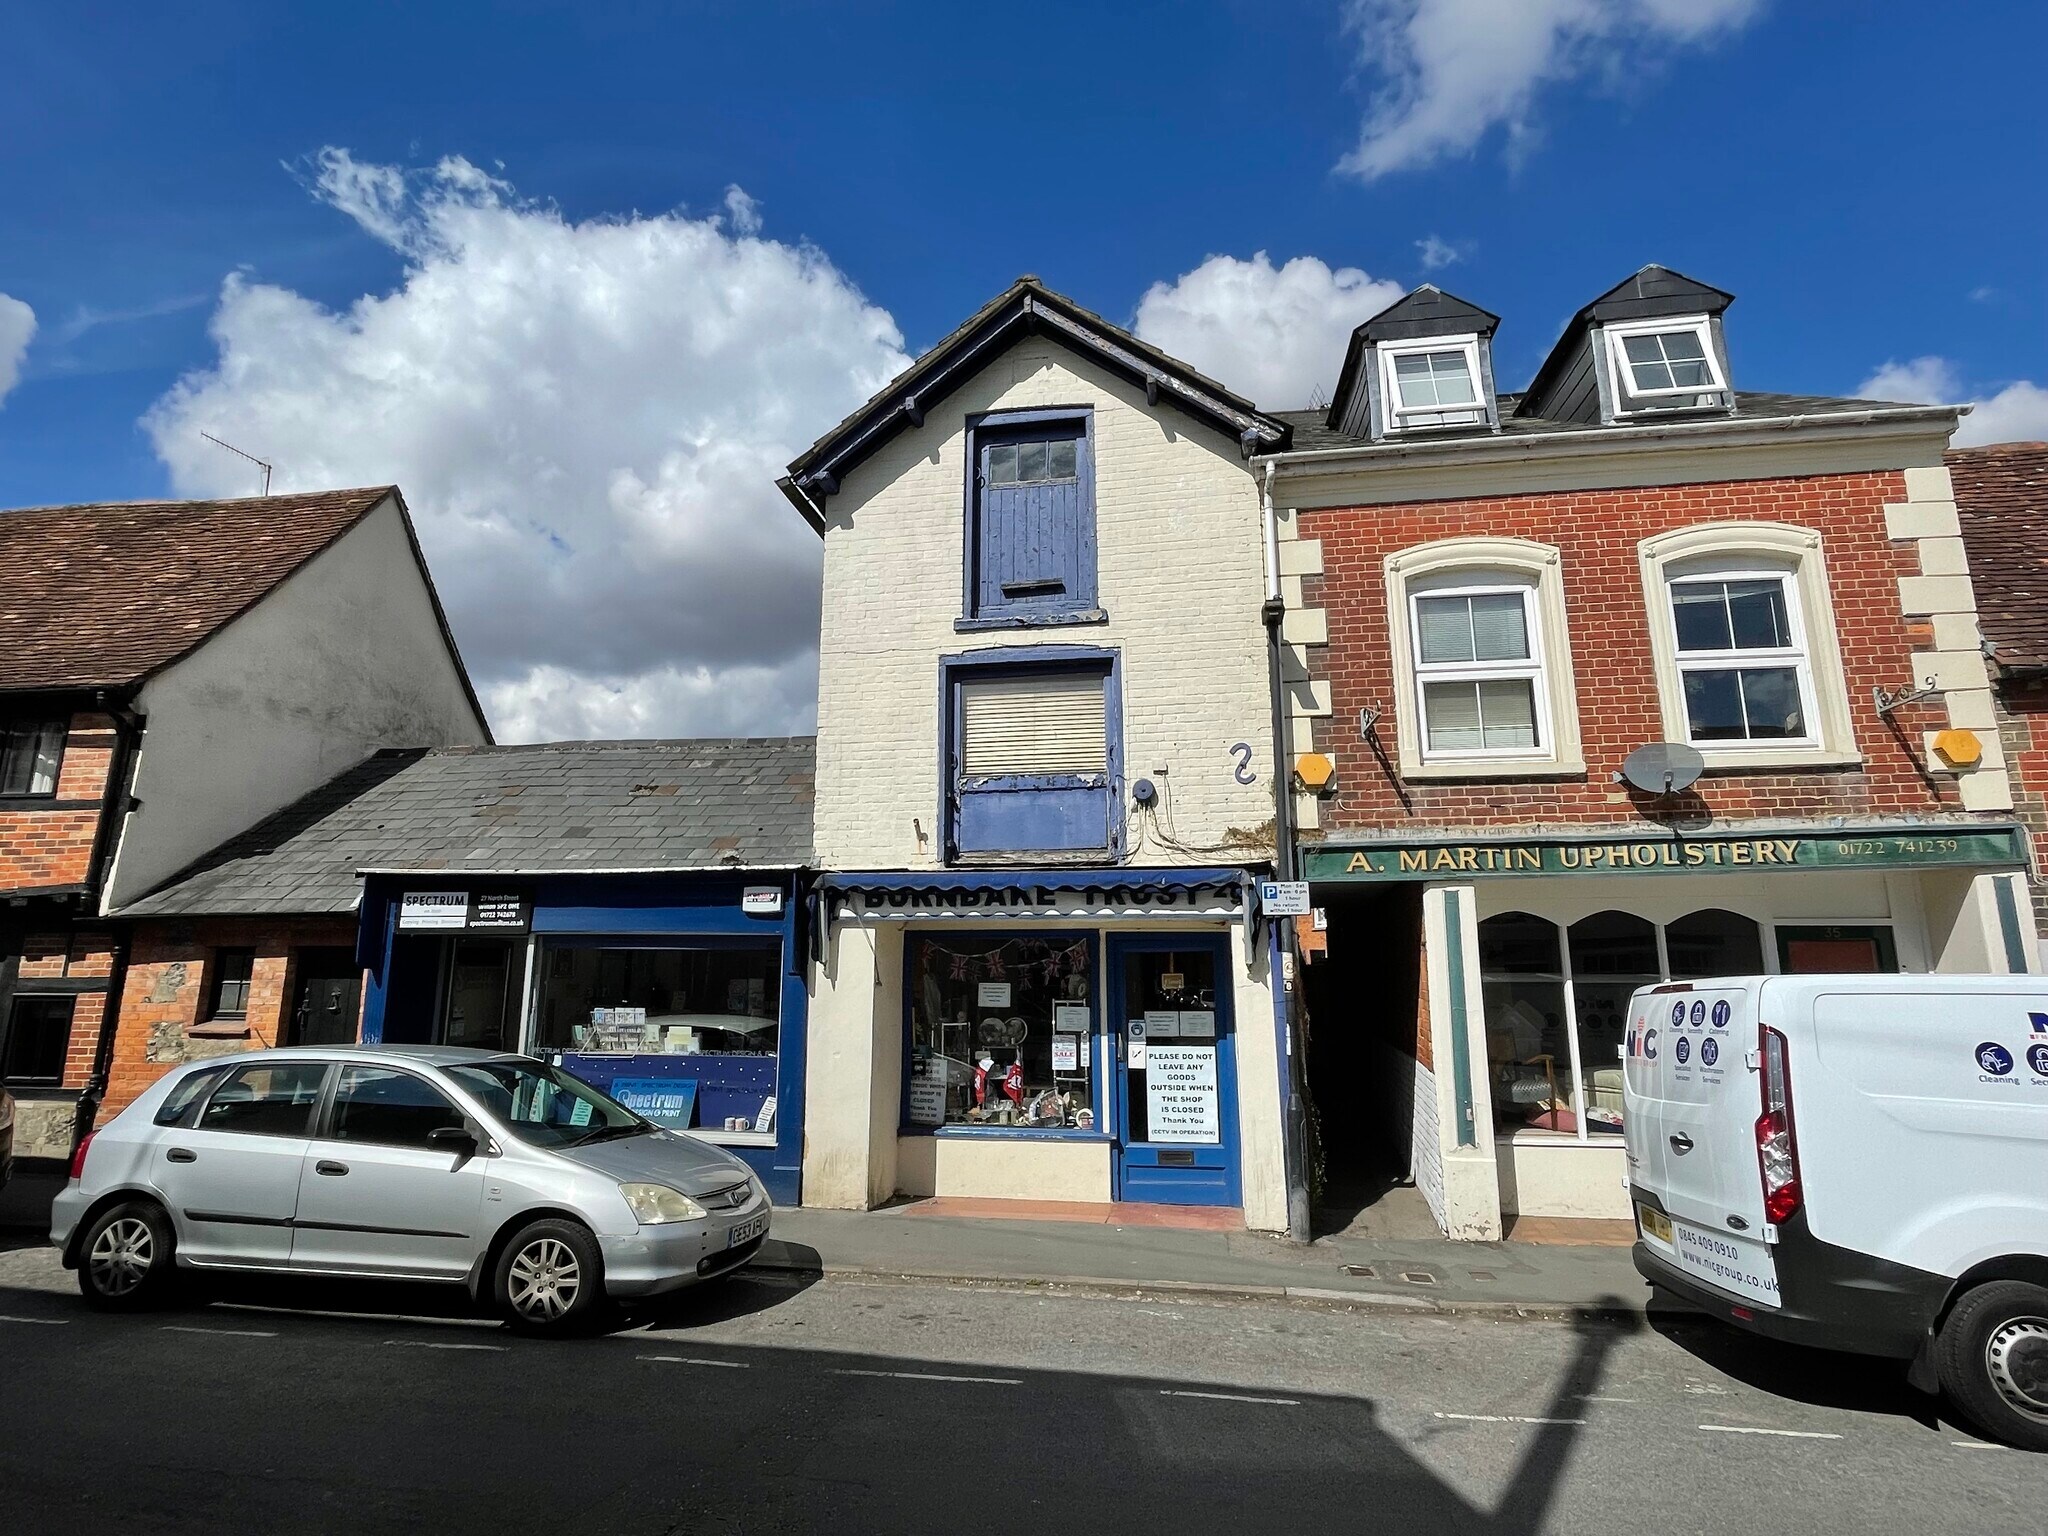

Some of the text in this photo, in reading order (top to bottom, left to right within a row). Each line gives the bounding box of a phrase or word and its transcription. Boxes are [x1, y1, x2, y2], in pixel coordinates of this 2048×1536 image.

[1838, 839, 1959, 856] 01722 741239
[1346, 839, 1801, 873] A. MARTIN UPHOLSTERY
[405, 895, 465, 906] SPECTRUM
[1824, 927, 1841, 938] 35
[1709, 1028, 1730, 1036] Catering
[1978, 1074, 2021, 1086] Cleaning
[617, 1089, 684, 1109] Spectrum
[661, 1109, 681, 1117] PRINT
[1678, 1227, 1738, 1260] 0845 409 0910
[1682, 1250, 1781, 1293] www.nicgroup.co.uk
